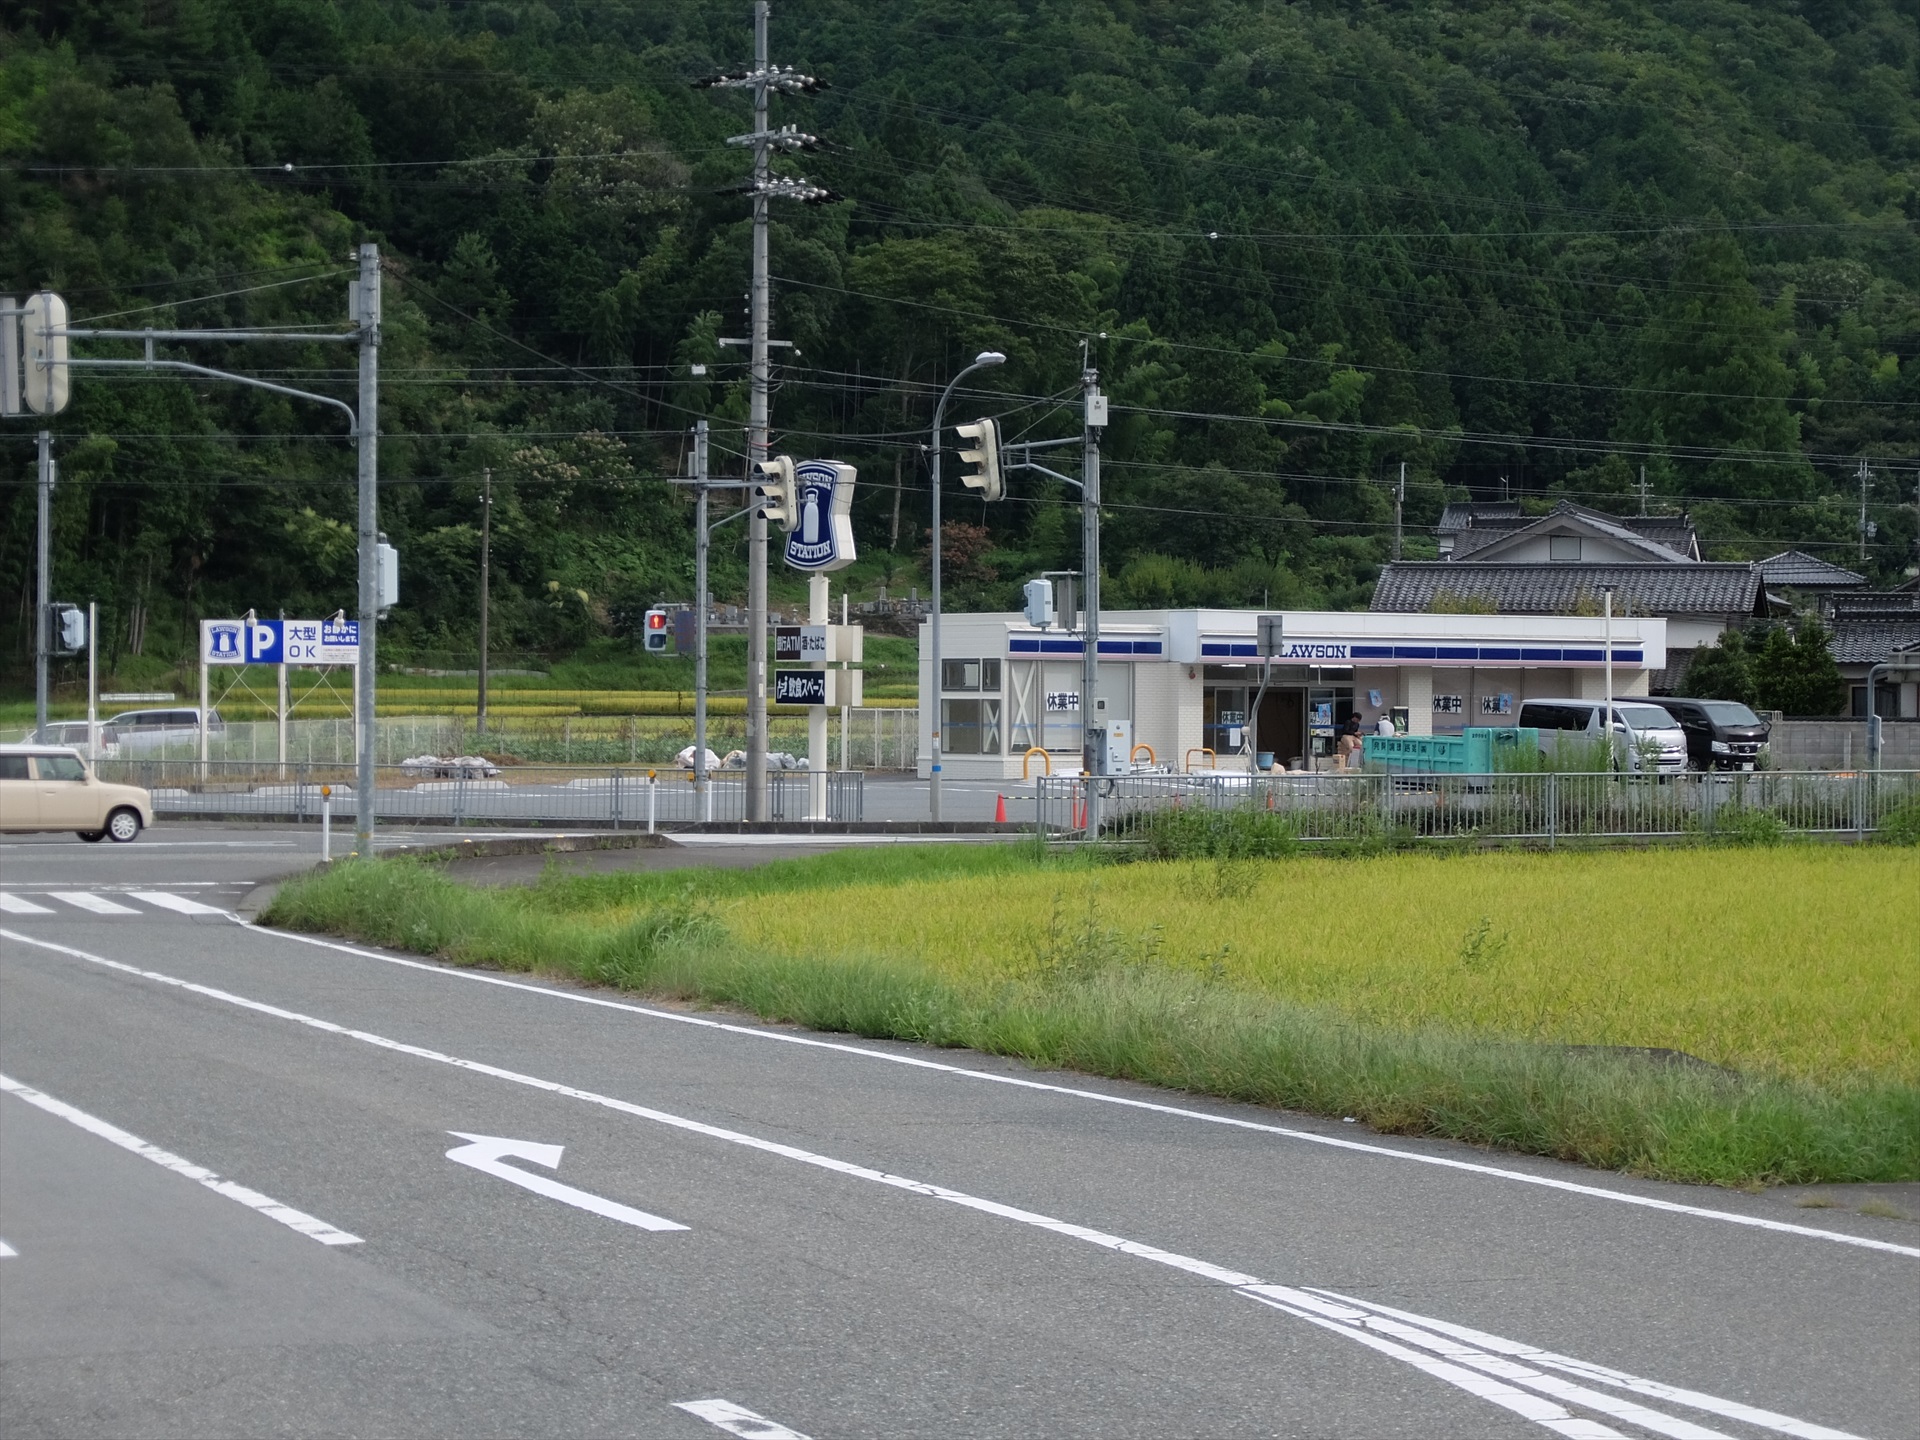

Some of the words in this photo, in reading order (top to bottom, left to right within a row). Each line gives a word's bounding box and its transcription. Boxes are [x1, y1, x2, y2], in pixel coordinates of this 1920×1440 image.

[790, 540, 831, 558] STATION
[252, 625, 275, 658] P
[289, 626, 316, 641] 大型
[289, 645, 316, 658] OK
[788, 677, 825, 698] 飲食スペース
[1047, 692, 1079, 710] 休業中
[1432, 695, 1462, 712] 休業中
[1483, 697, 1508, 713] 休業
